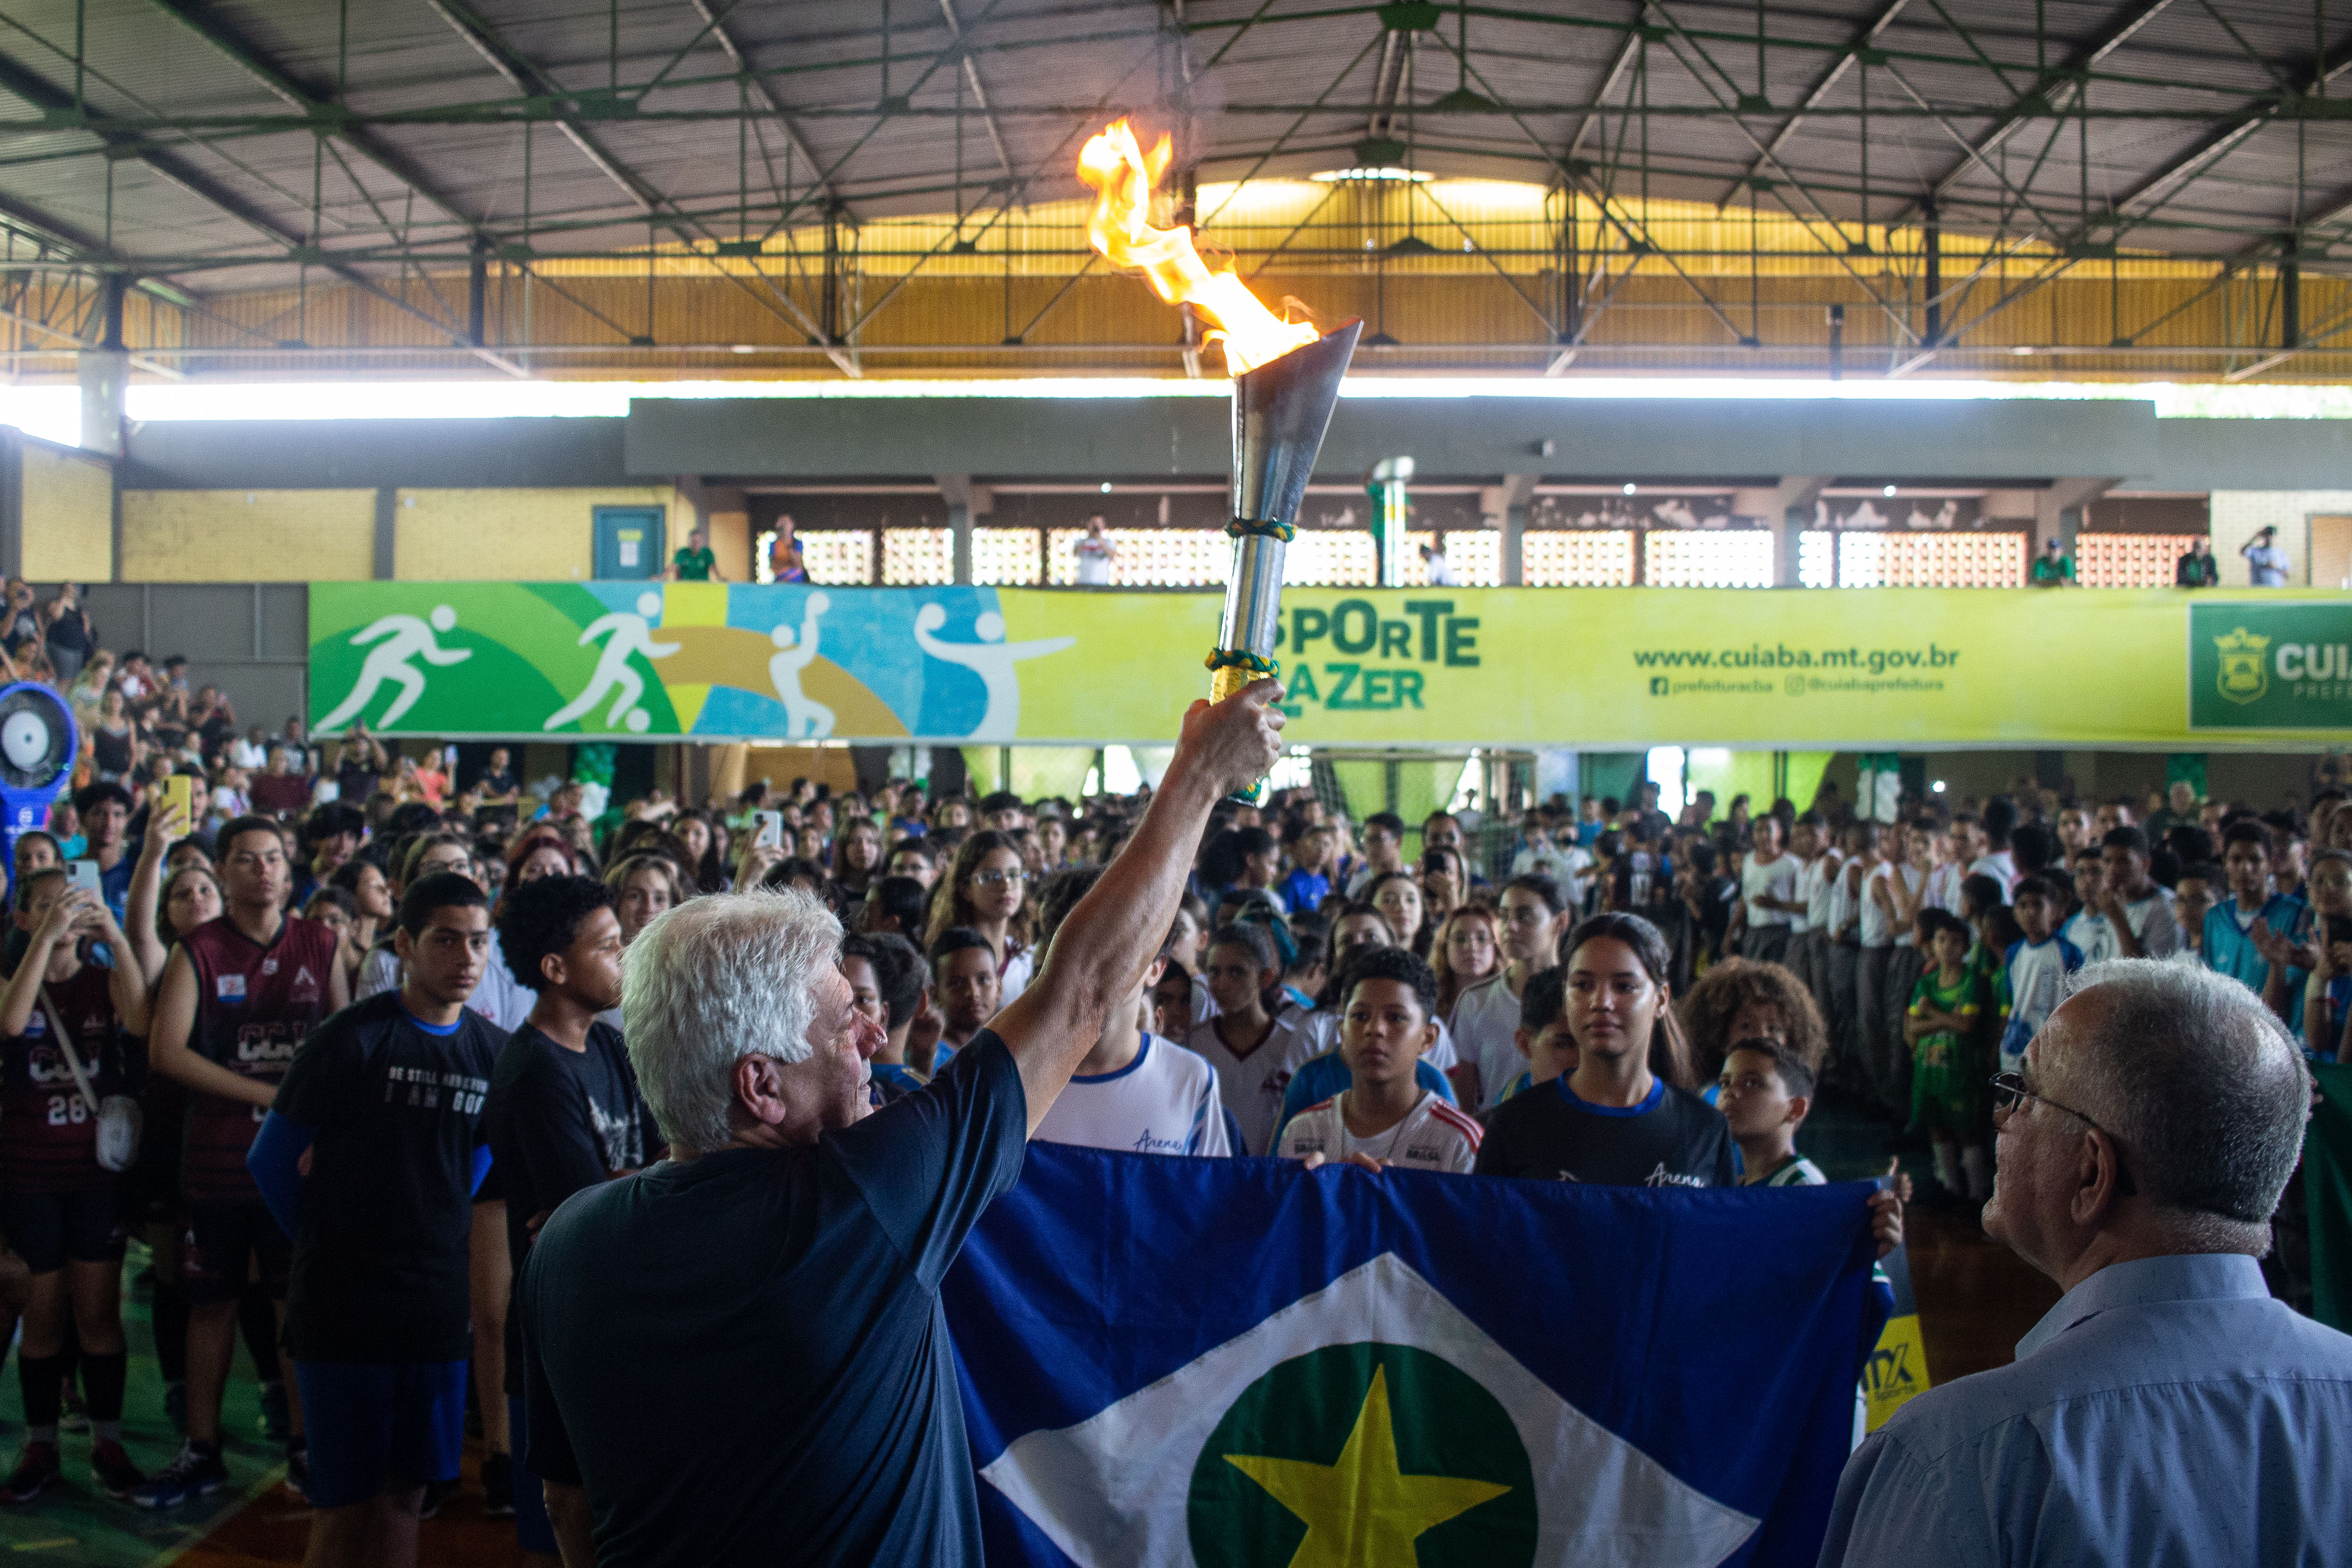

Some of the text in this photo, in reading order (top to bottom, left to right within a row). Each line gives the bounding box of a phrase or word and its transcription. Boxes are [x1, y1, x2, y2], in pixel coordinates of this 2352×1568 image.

[1219, 599, 1481, 667] PORTE
[1633, 644, 1960, 674] www.cuiaba.mt.gov.br
[2276, 643, 2352, 681] CUI
[388, 1065, 404, 1081] BE
[407, 1068, 438, 1085] STILL
[1133, 1128, 1182, 1153] Arena
[1644, 1160, 1706, 1188] Arena
